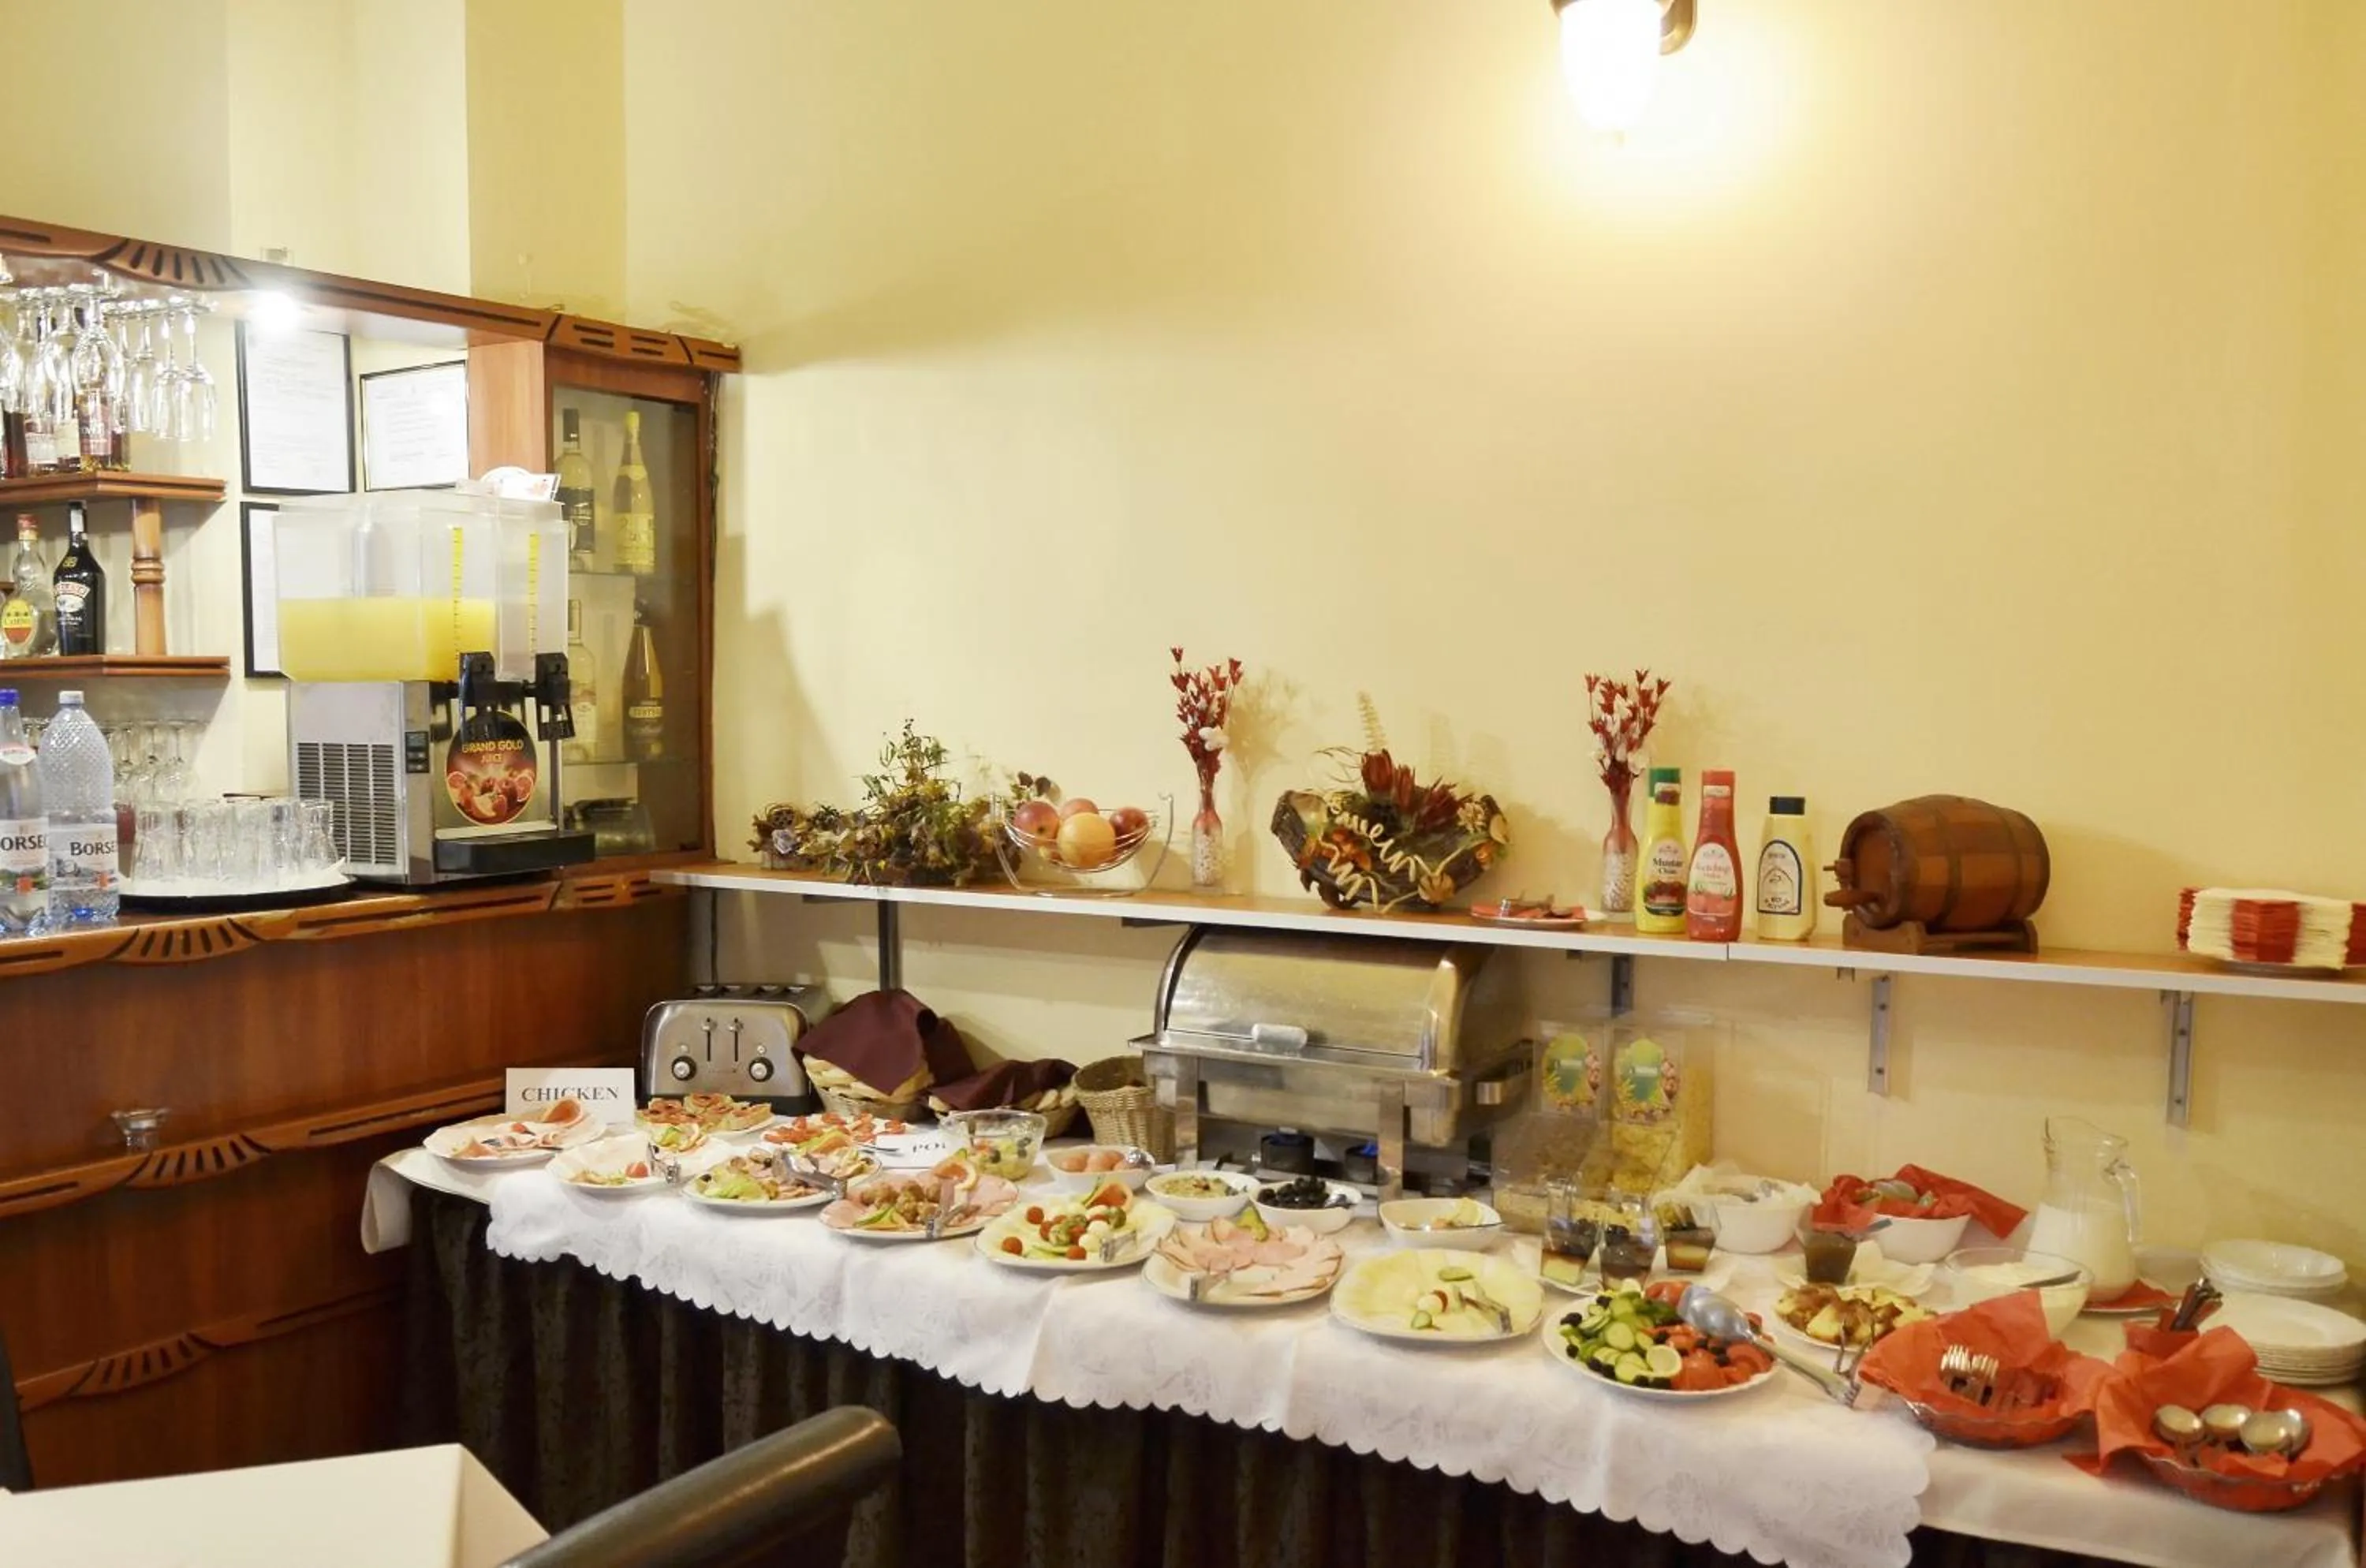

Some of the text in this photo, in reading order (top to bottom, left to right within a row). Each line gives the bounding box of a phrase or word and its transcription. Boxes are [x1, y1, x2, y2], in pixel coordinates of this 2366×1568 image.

[461, 739, 524, 754] GRAND GOLD
[521, 1086, 619, 1103] CHICKEN
